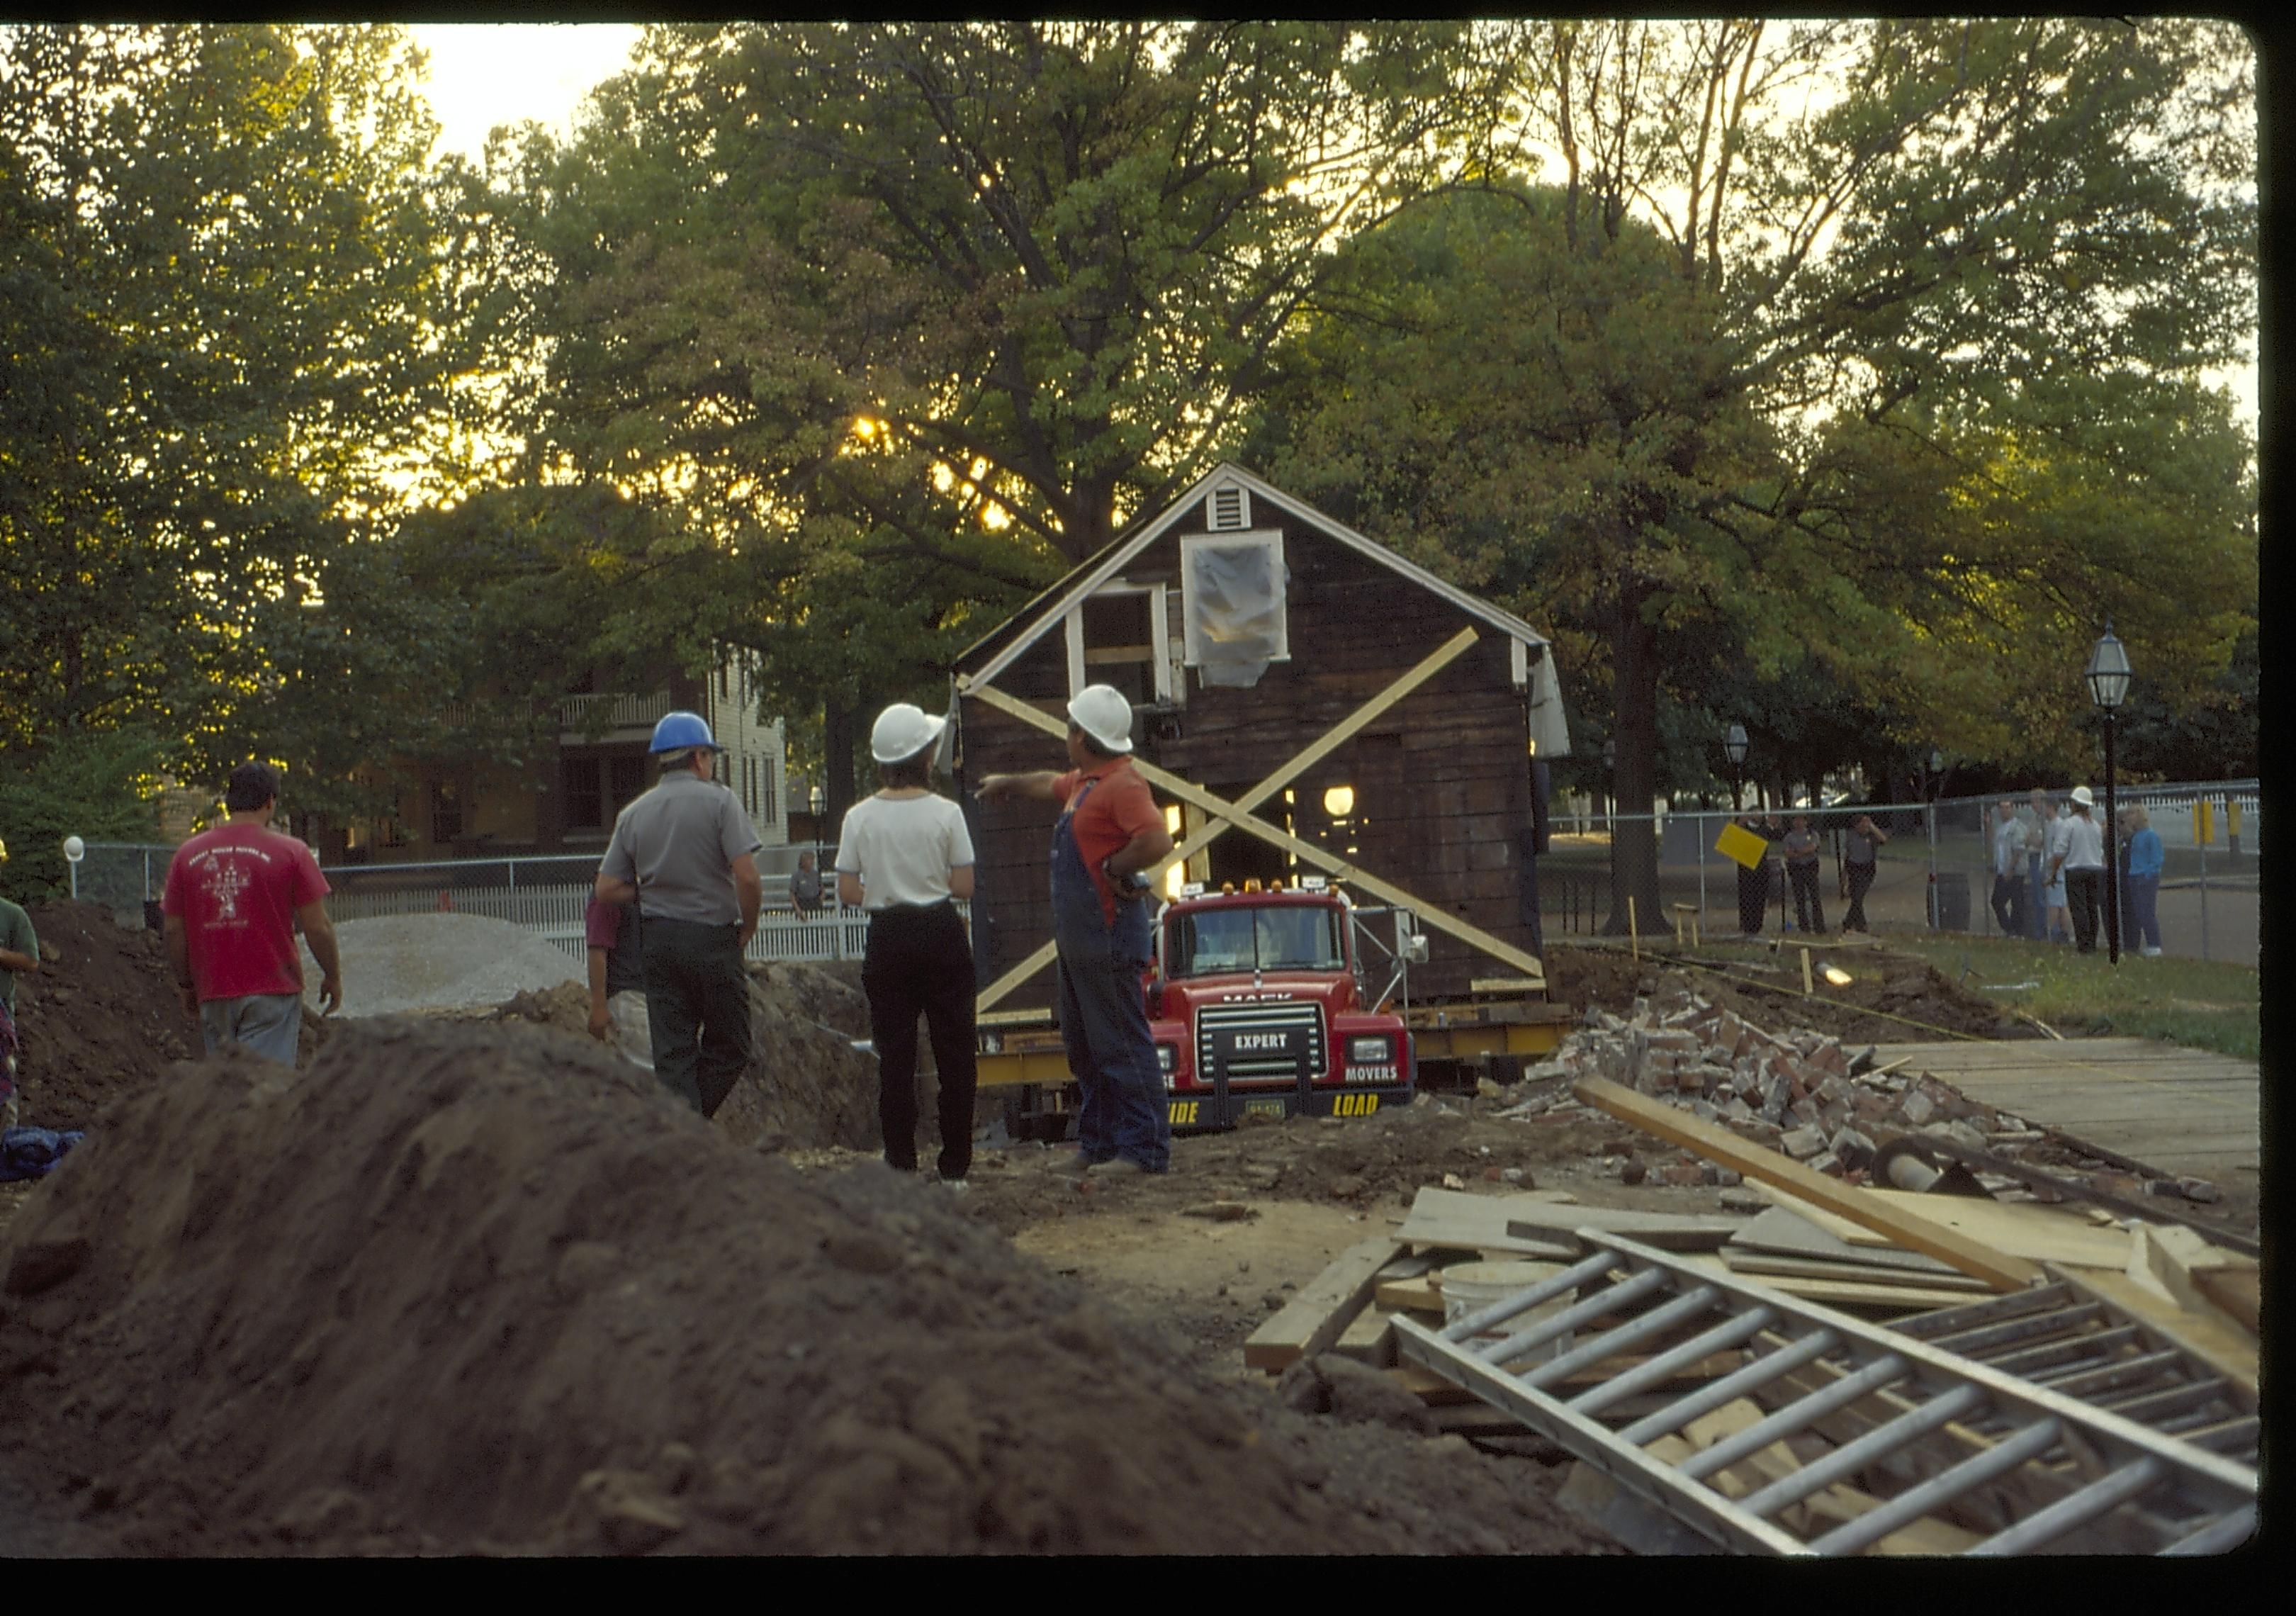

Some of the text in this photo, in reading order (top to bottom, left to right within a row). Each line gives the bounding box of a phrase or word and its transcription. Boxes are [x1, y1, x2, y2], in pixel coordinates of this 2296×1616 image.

[1235, 1033, 1288, 1049] EXPERT
[1346, 1066, 1398, 1082] MOVERS
[1167, 1094, 1379, 1124] IDE LOAD
